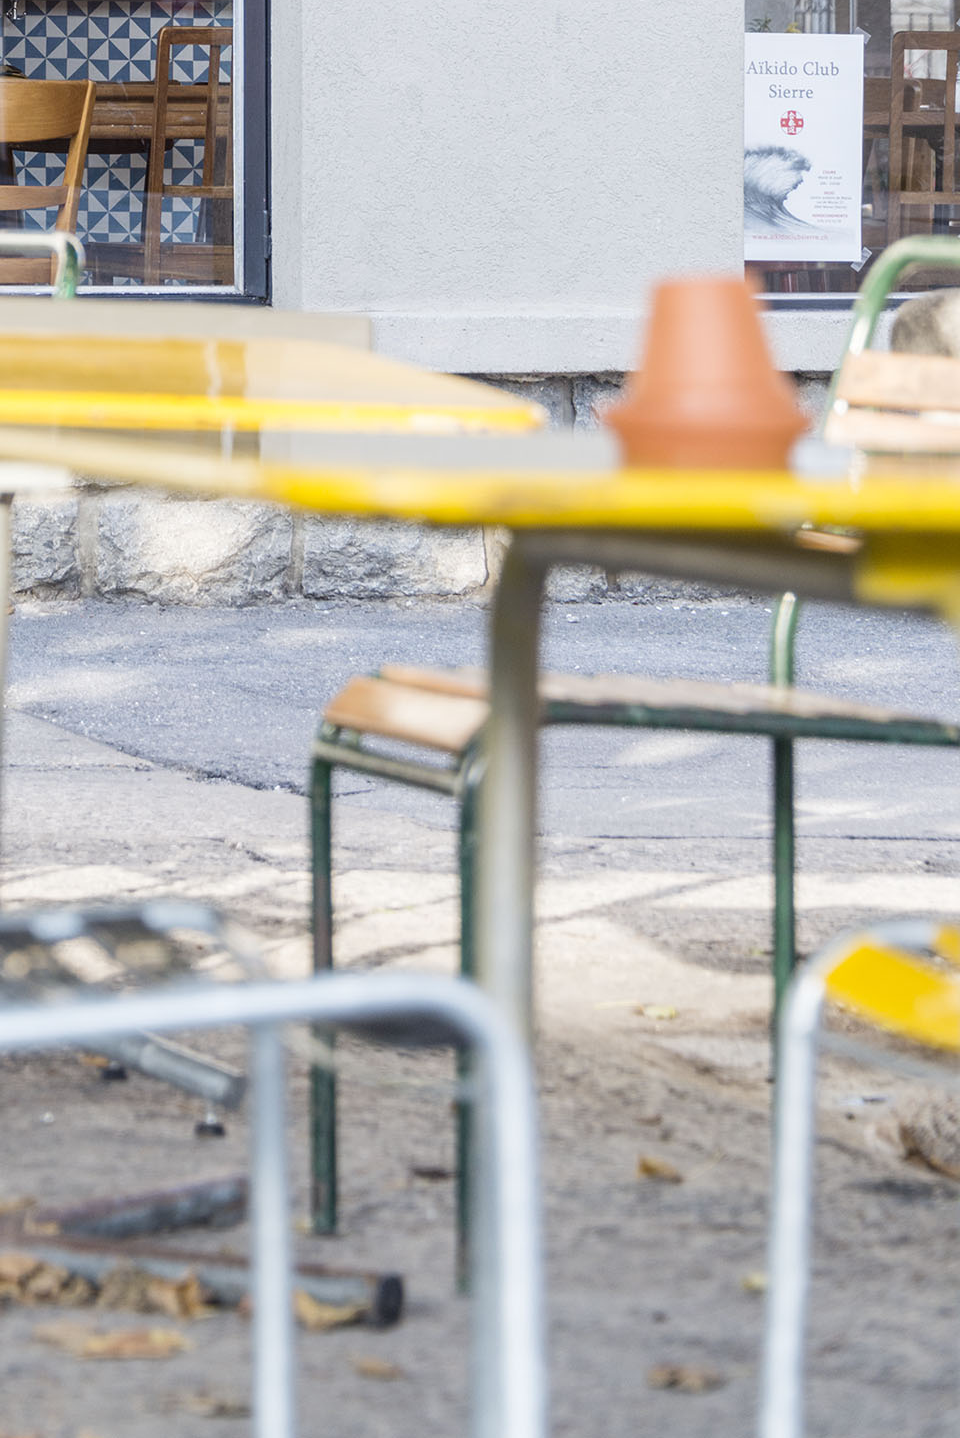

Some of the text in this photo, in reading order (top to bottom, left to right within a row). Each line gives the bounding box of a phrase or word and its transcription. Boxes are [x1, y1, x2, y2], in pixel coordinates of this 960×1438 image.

[746, 60, 840, 76] Aïkido Club
[768, 84, 814, 99] Sierre
